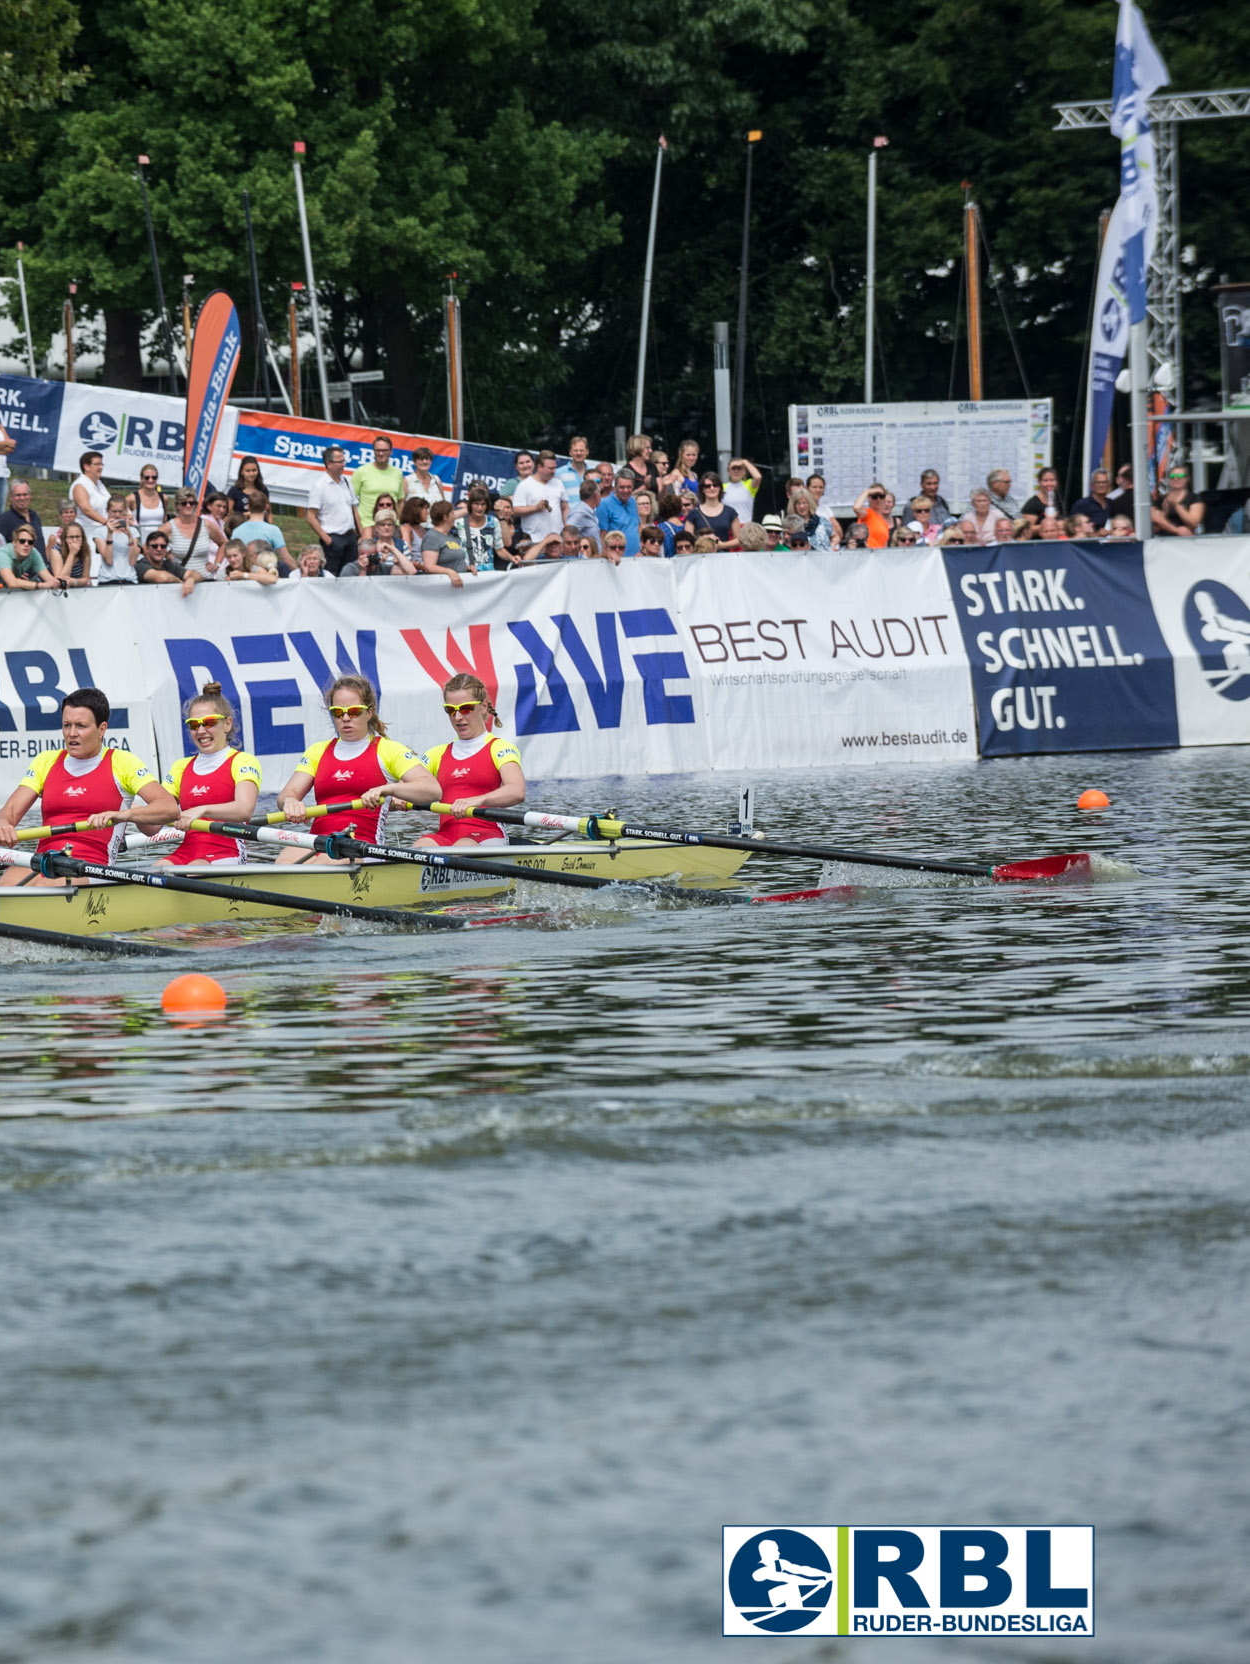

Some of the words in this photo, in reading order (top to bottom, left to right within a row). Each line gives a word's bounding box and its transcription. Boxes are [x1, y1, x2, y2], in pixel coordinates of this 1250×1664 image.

[187, 330, 240, 490] Sparda-Bank
[125, 416, 185, 452] RB
[960, 568, 1085, 617] STARK.
[689, 619, 808, 664] BEST
[831, 615, 949, 659] AUDIT
[976, 625, 1145, 674] SCHNELL.
[399, 607, 695, 737] WAVE
[709, 667, 908, 687] Wirtschaftsprüfungsgesellschaft
[990, 686, 1066, 732] GUT.
[841, 729, 968, 748] www.bestaudit.de
[743, 788, 749, 819] 1
[538, 815, 565, 828] Melitta
[148, 832, 182, 843] Melitta
[626, 828, 644, 837] STARK.
[644, 830, 670, 840] SCHNELL.
[670, 833, 683, 841] GUT.
[368, 846, 387, 856] STARK.
[387, 850, 413, 860] SCHNELL.
[414, 854, 427, 862] GUT.
[84, 865, 104, 876] STARK.
[105, 869, 131, 880] SCHNELL.
[132, 873, 145, 883] GUT.
[432, 865, 451, 884] RBL
